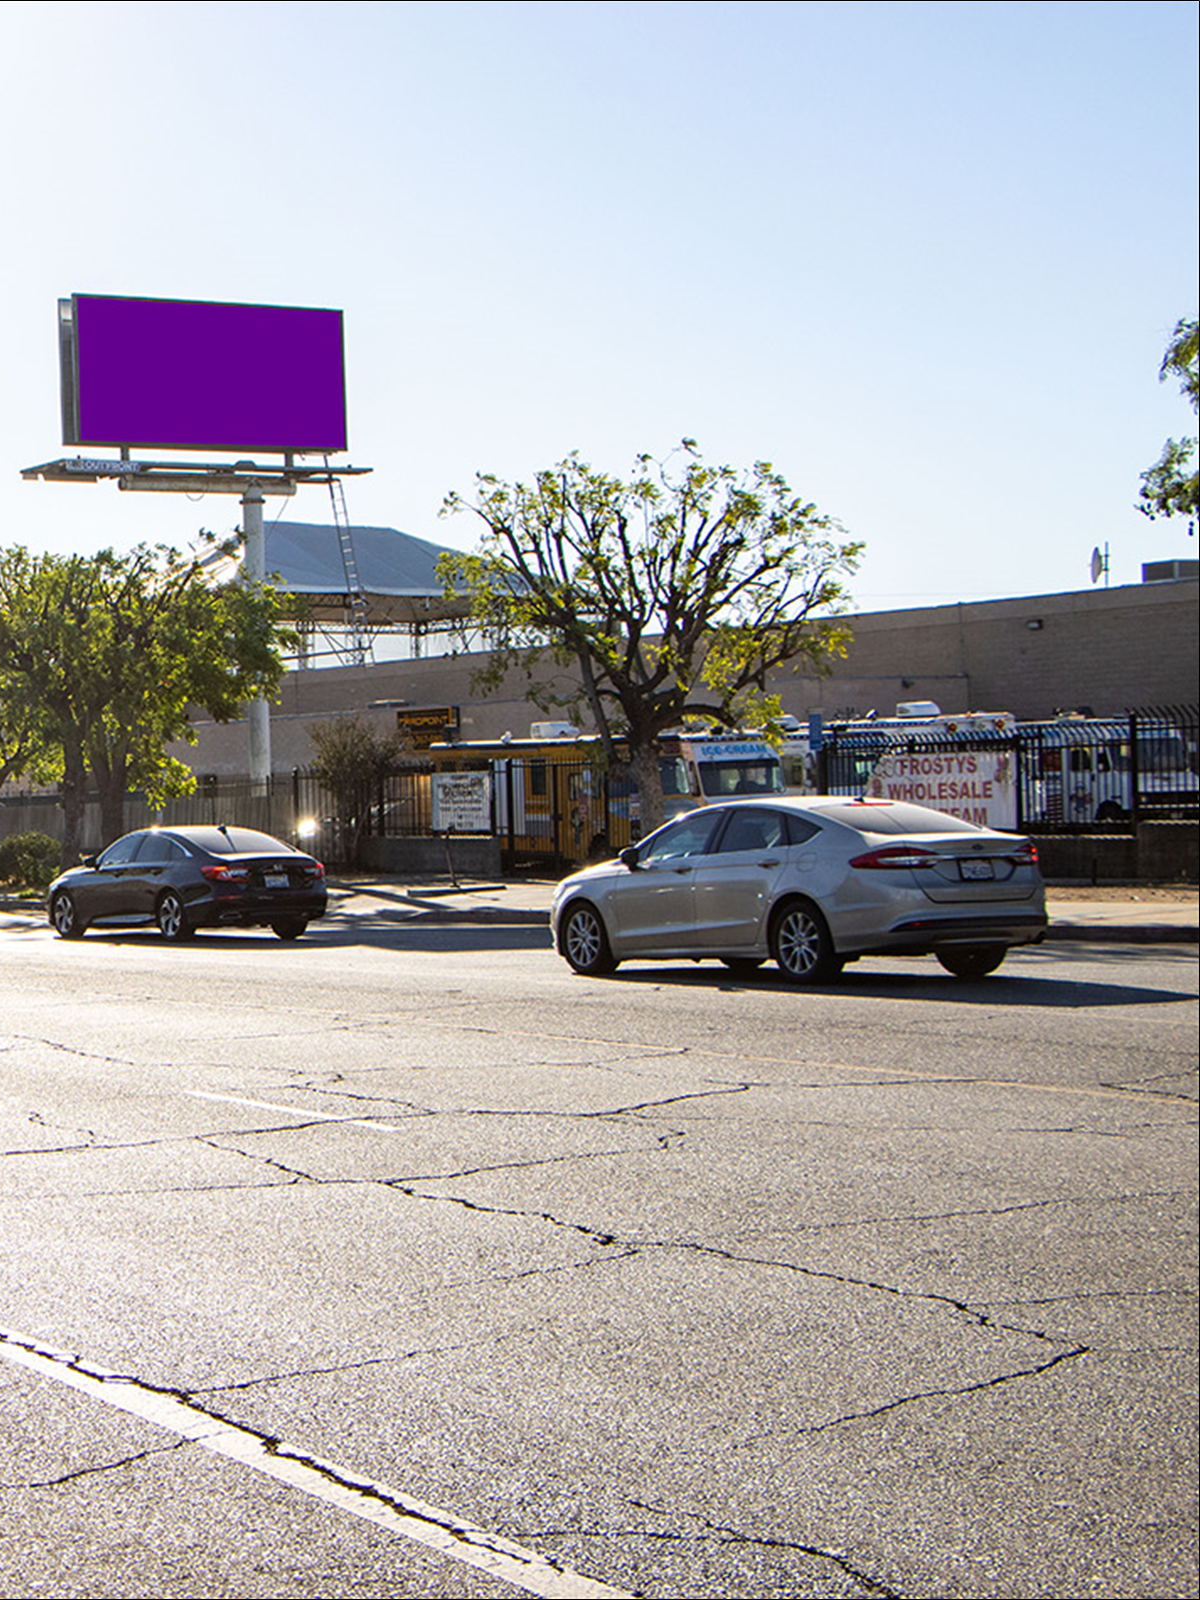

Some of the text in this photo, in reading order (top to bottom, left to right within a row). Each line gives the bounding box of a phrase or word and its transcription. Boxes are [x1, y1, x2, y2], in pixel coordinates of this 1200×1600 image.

[900, 756, 978, 776] FROSTYS
[887, 780, 993, 801] WHOLESALE
[939, 807, 988, 826] EAM
